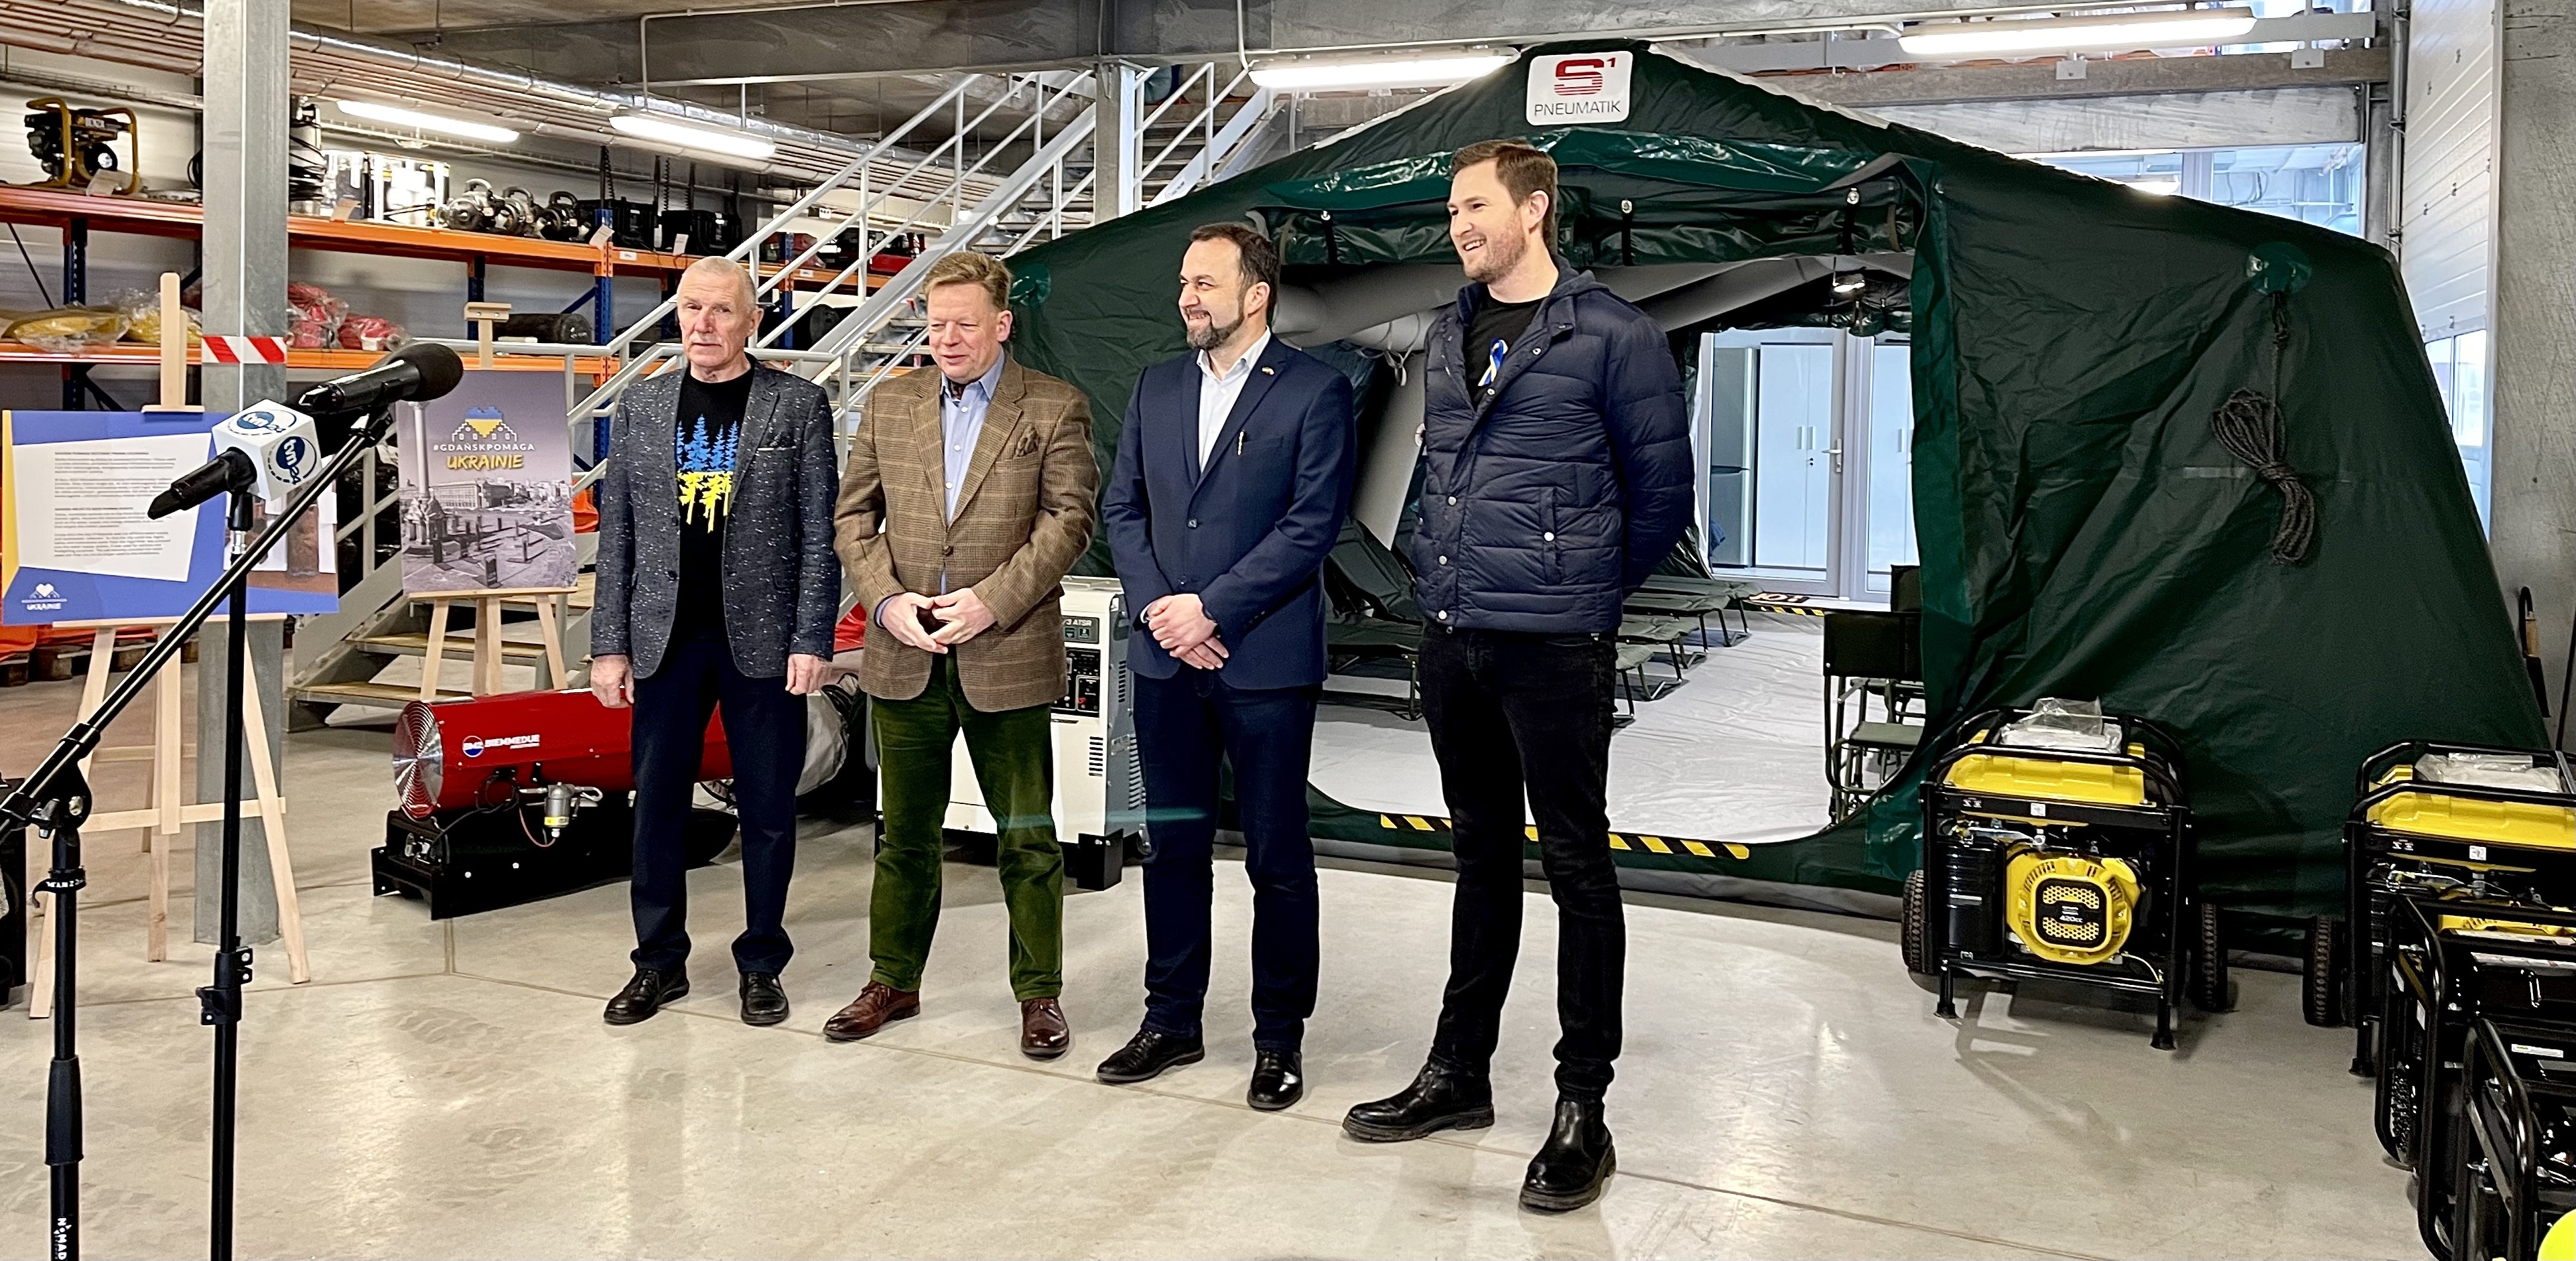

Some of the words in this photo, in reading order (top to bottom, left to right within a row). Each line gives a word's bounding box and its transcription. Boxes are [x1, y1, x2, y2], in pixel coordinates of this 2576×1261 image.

[1534, 101, 1621, 117] PNEUMATIK
[446, 454, 524, 471] UKRAINIE
[484, 734, 540, 748] BIEMMEDUE
